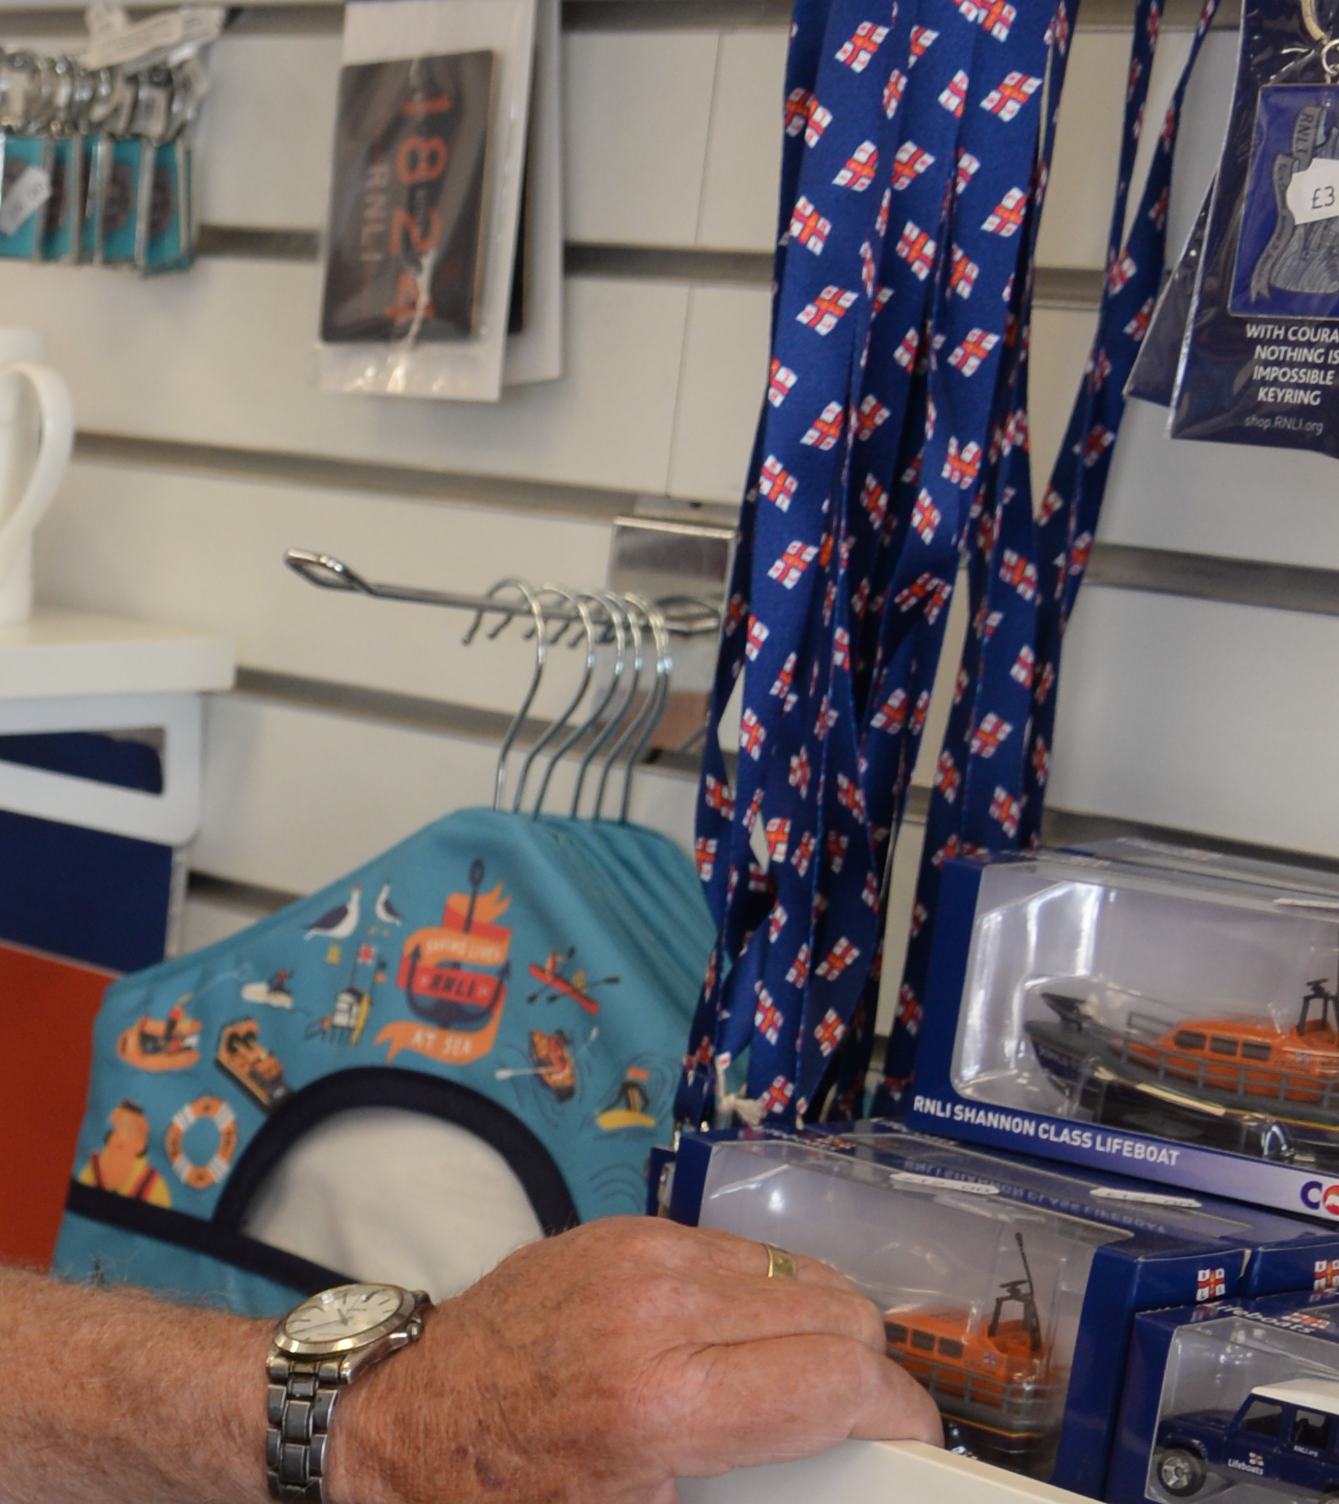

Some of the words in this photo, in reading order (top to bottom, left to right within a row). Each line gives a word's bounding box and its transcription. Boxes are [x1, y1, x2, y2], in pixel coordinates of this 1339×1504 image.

[1246, 323, 1285, 340] WITH
[1287, 325, 1339, 344] COURA
[1254, 344, 1325, 364] NOTHING
[1252, 365, 1335, 386] IMPOSSIBLE
[1257, 386, 1322, 406] KEYRING
[912, 1095, 951, 1119] RNLI
[953, 1103, 1036, 1138] SHANNON
[1037, 1122, 1093, 1148] CLASS
[1095, 1135, 1180, 1167] LIFEBOAT
[1227, 1457, 1264, 1476] Lifeboats
